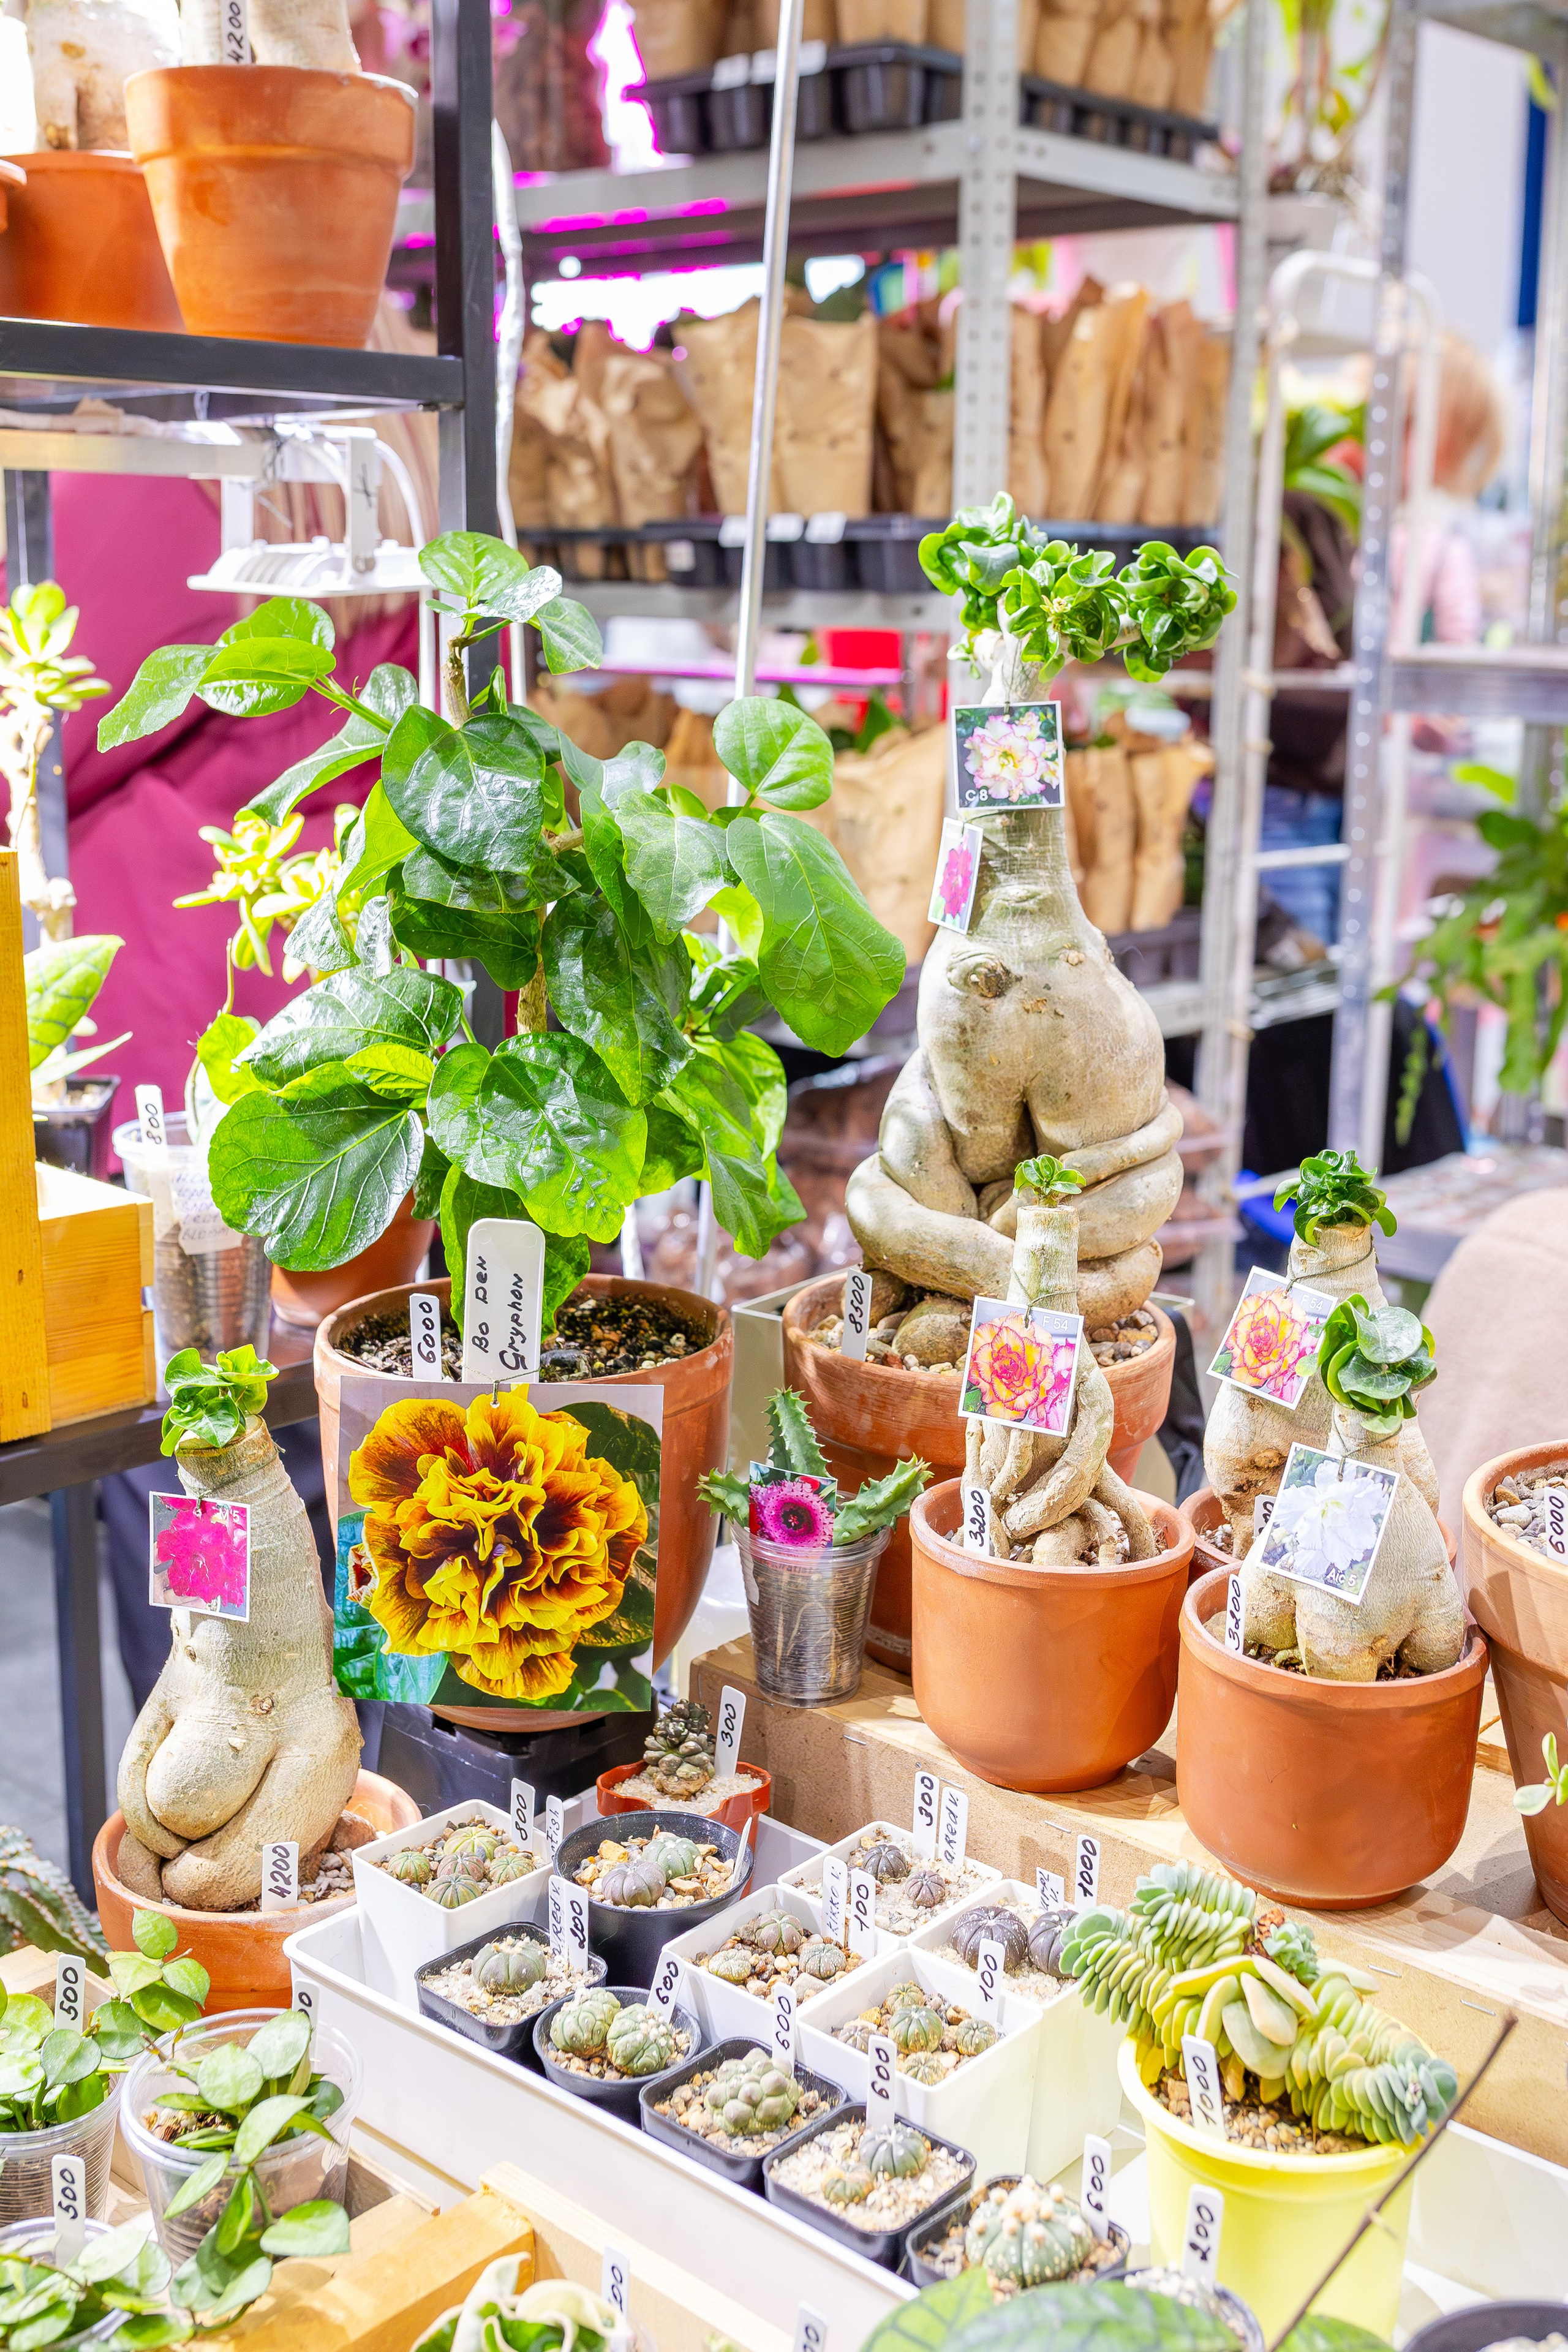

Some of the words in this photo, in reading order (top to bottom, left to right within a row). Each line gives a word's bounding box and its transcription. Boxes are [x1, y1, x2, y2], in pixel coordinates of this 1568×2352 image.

[227, 1, 244, 64] 4200
[965, 788, 976, 802] C
[979, 788, 989, 802] 8
[145, 1103, 162, 1145] 800
[848, 1275, 865, 1334] 8500
[1042, 1315, 1051, 1327] F
[1053, 1317, 1069, 1331] 54
[1300, 1293, 1308, 1305] F
[1310, 1297, 1324, 1311] 54
[417, 1301, 436, 1364] 6000
[232, 1510, 241, 1523] 5
[969, 1490, 986, 1547] 3200
[1550, 1496, 1566, 1554] 6000
[1347, 1574, 1357, 1586] 5
[1226, 1579, 1241, 1651] 3200
[720, 1703, 736, 1747] 300
[516, 1793, 528, 1841] 800
[918, 1776, 934, 1826] 300
[268, 1845, 292, 1898] 4200
[1077, 1839, 1097, 1898] 1000
[854, 1884, 870, 1931] 100
[59, 1966, 78, 2021] 500
[656, 1961, 679, 2005] 600
[979, 1953, 999, 2002] 100
[776, 1995, 792, 2050] 600
[872, 2047, 889, 2100] 600
[1191, 2056, 1216, 2127] 1000
[58, 2167, 76, 2220] 500
[1087, 2154, 1104, 2212] 600
[1189, 2202, 1214, 2261] 200
